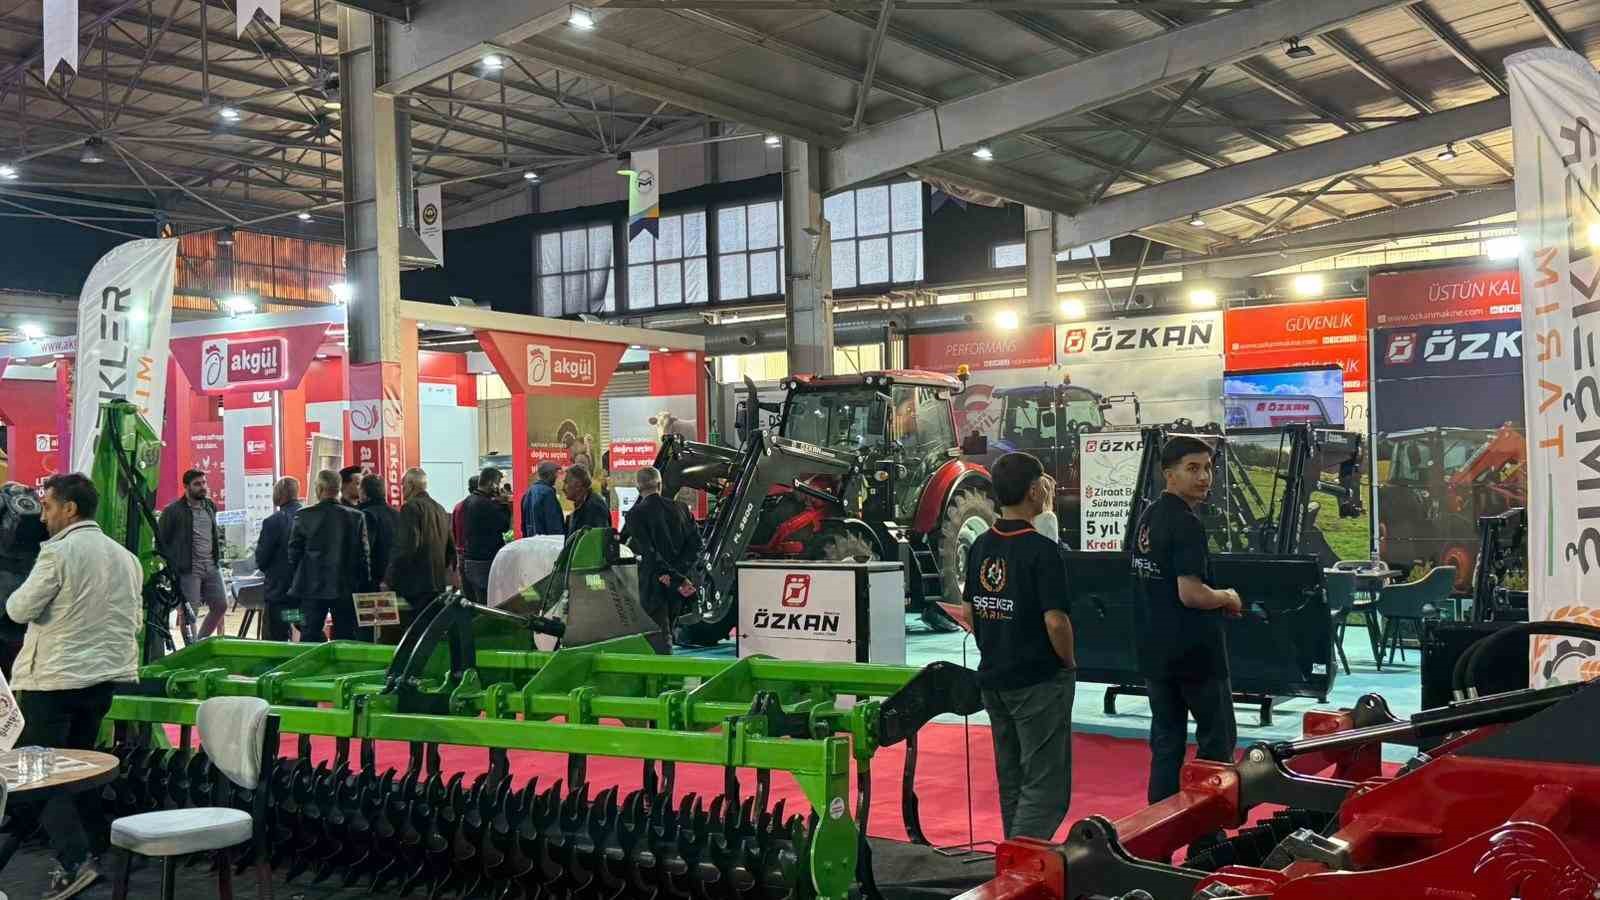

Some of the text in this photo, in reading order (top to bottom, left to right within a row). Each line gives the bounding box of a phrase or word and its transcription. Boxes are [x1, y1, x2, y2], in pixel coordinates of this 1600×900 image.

[1428, 280, 1485, 302] ÜSTÜN
[1286, 313, 1353, 332] GÜVENLİK
[1091, 324, 1213, 351] ÖZKAN
[231, 346, 278, 374] akgül
[554, 356, 592, 378] akgül
[1095, 488, 1123, 496] Ziraat
[1087, 521, 1120, 538] 5 yıl
[1087, 540, 1117, 549] Kredi
[753, 608, 840, 632] ÖZKAN
